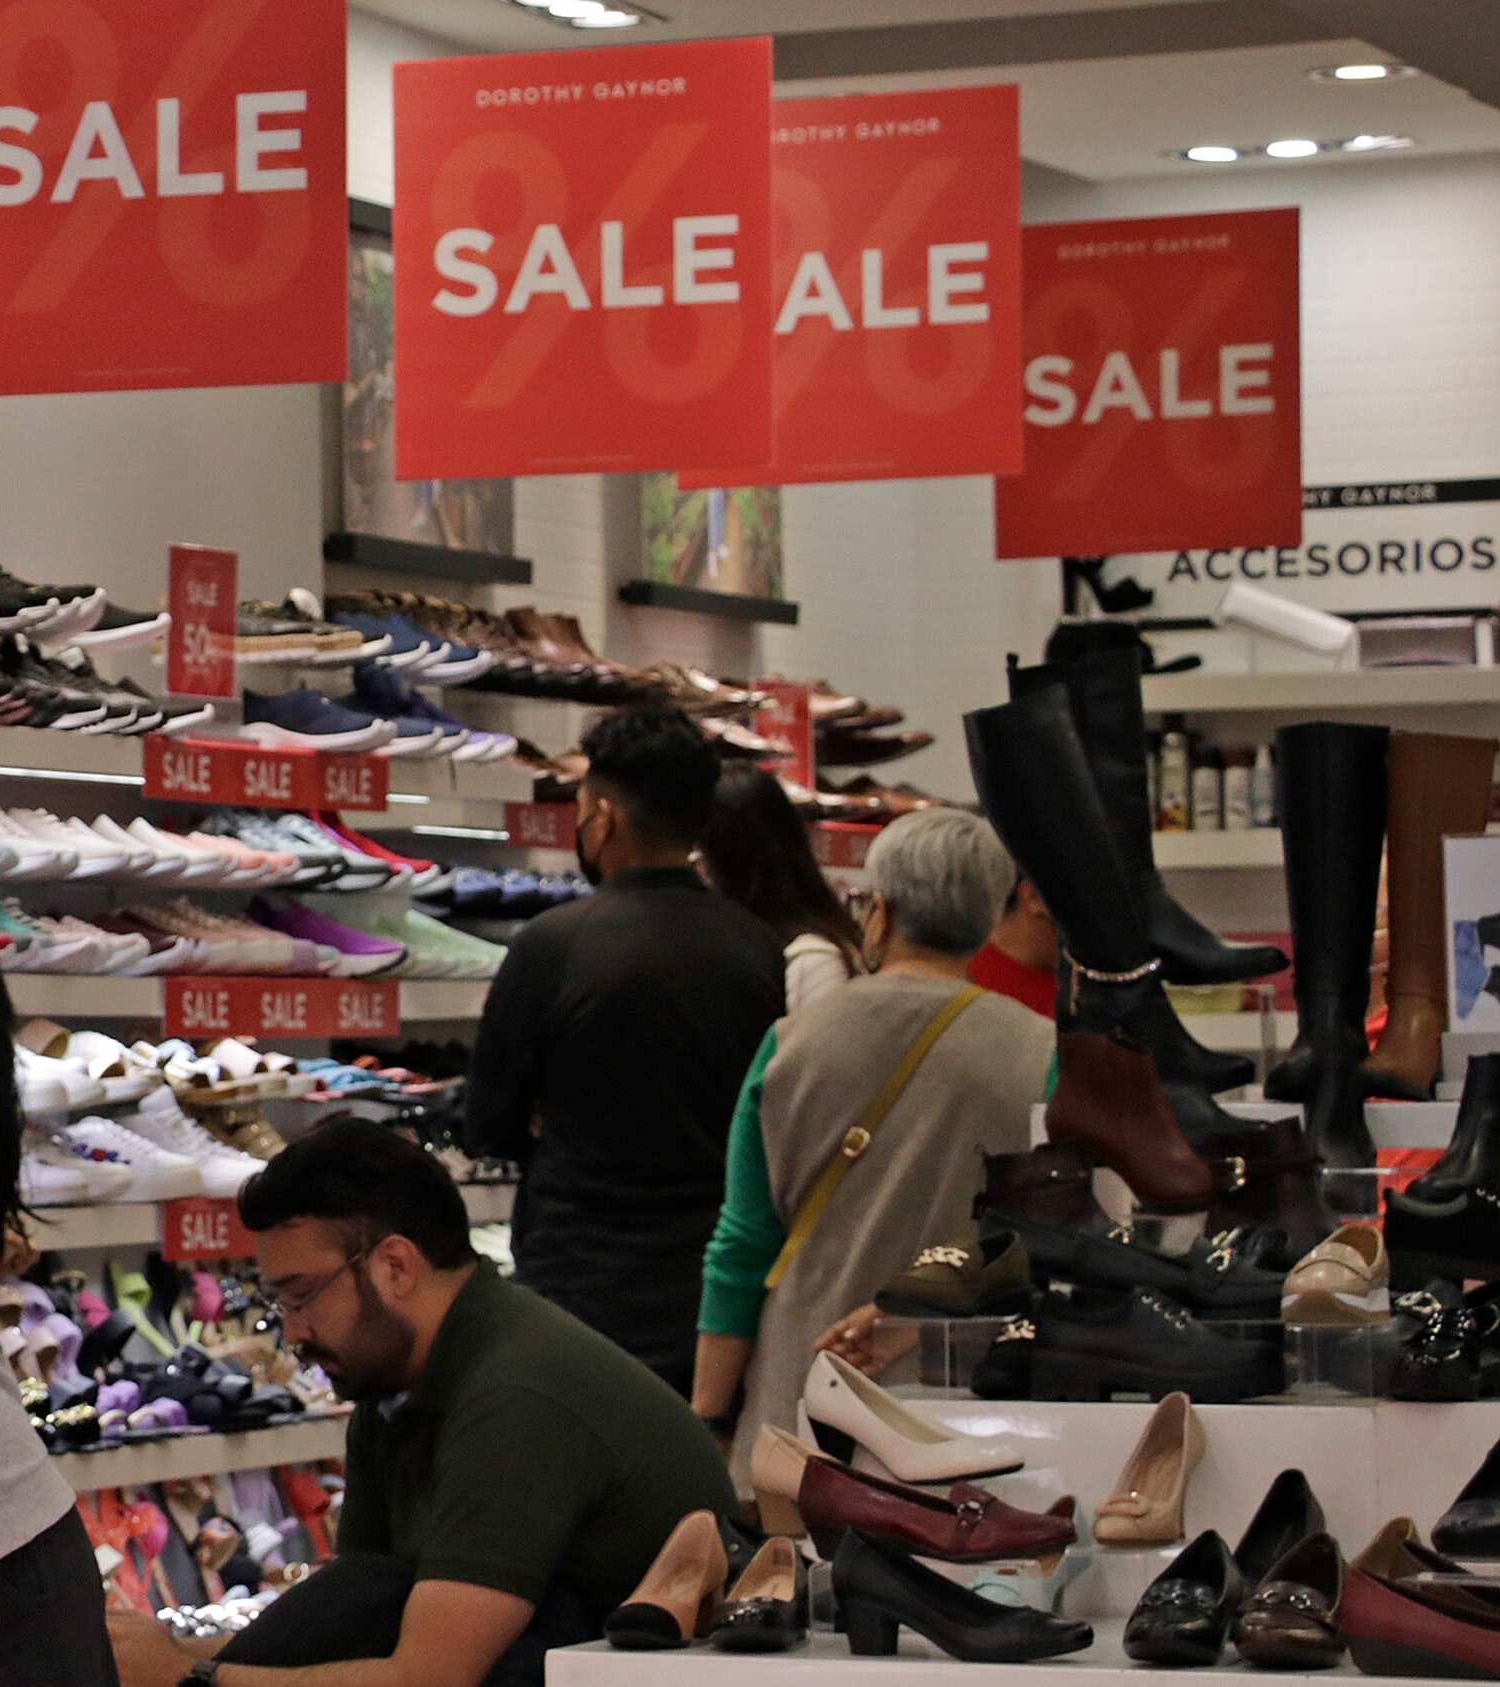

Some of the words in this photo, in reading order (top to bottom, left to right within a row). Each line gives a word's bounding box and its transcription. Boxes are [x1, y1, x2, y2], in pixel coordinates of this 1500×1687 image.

[476, 84, 583, 108] DOROTHY
[593, 77, 686, 101] GAYNOR
[855, 117, 940, 140] GAYNOR
[432, 214, 740, 317] SALE
[773, 242, 990, 335] ALE
[1024, 343, 1274, 427] SALE
[1339, 484, 1437, 506] GAYNOR
[1167, 536, 1497, 582] ACCESORIOS
[163, 752, 211, 793] SALE
[244, 760, 292, 799] SALE
[326, 767, 372, 804] SALE
[183, 990, 230, 1029] SALE
[261, 992, 307, 1030] SALE
[339, 993, 384, 1029] SALE
[181, 1212, 229, 1250] SALE
